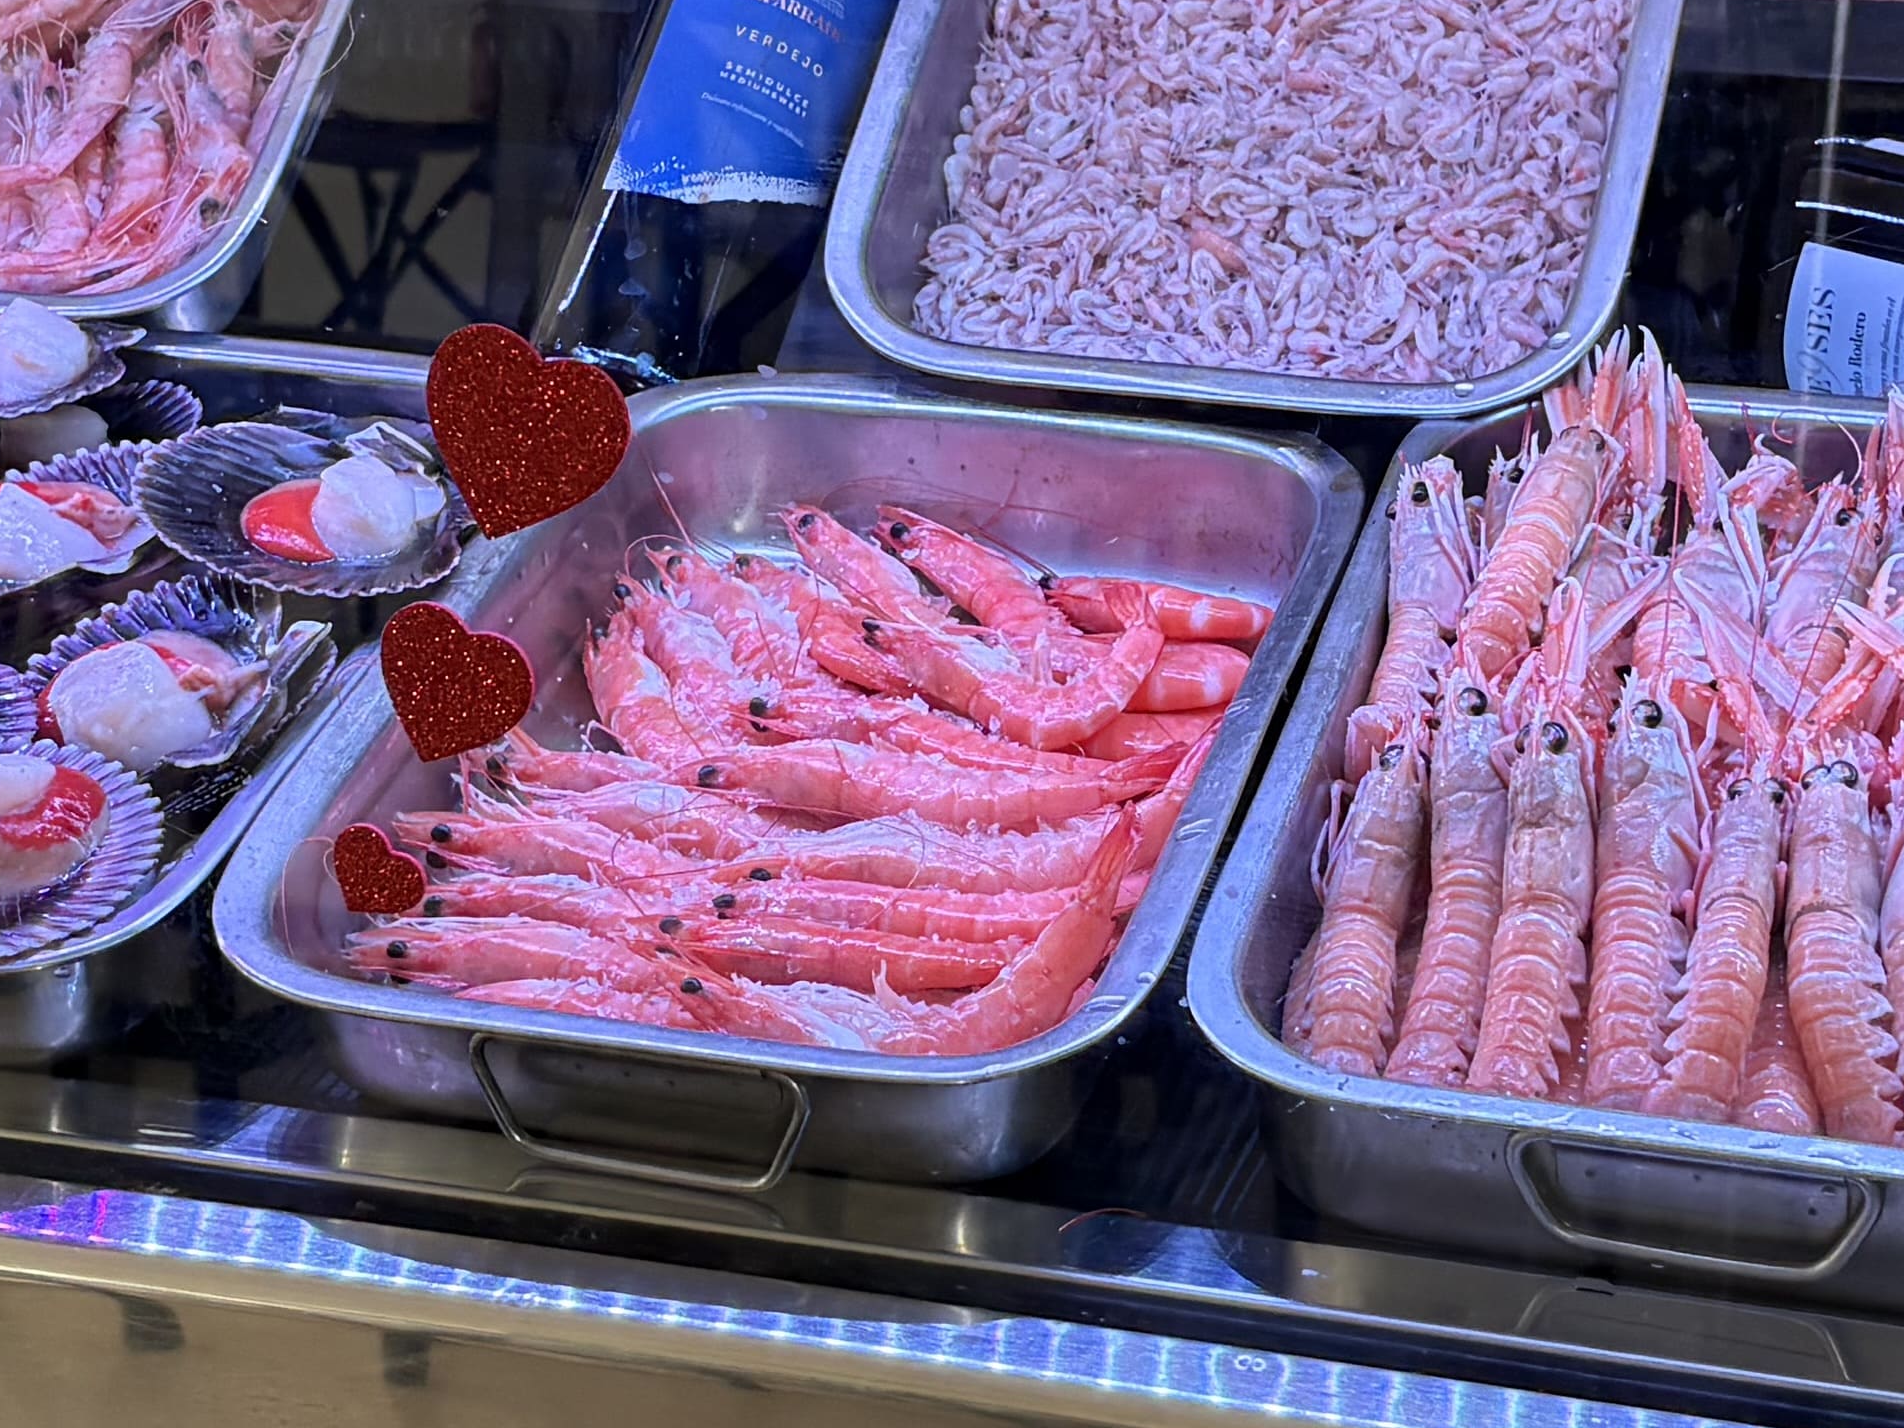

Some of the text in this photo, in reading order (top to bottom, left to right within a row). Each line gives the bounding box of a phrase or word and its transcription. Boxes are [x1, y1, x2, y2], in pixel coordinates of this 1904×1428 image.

[736, 23, 824, 77] VERDEJO
[726, 61, 809, 109] SEMIDULCE
[1848, 312, 1867, 367] Rodero
